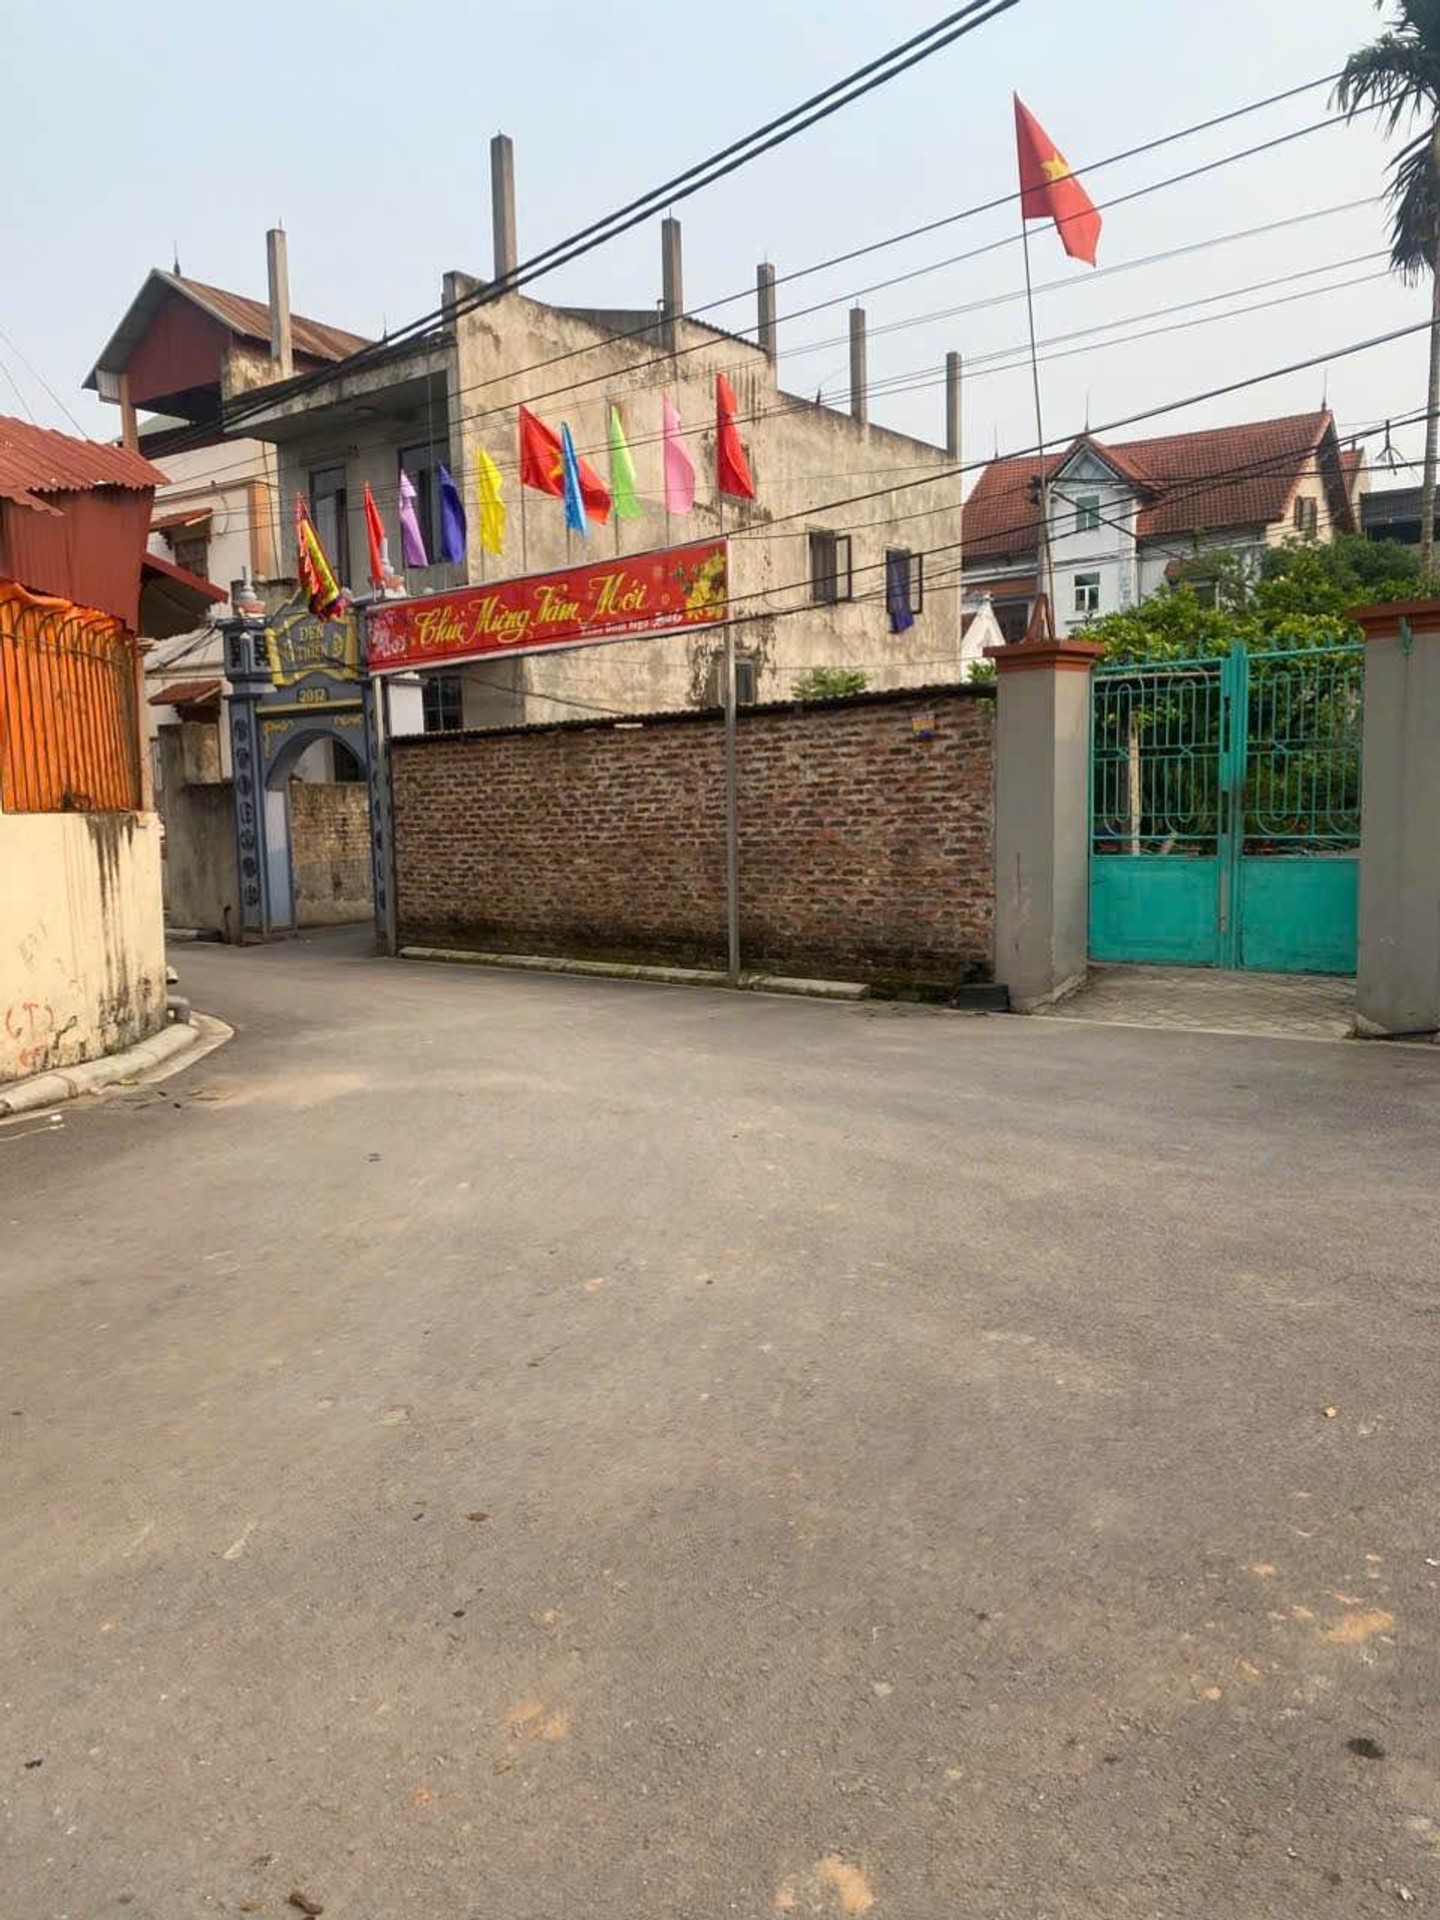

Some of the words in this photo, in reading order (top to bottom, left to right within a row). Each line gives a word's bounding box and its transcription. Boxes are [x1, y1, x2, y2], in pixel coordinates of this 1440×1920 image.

[415, 606, 468, 648] Chúc
[464, 595, 533, 644] Mừng
[530, 584, 581, 625] Năm
[588, 572, 649, 620] Mới
